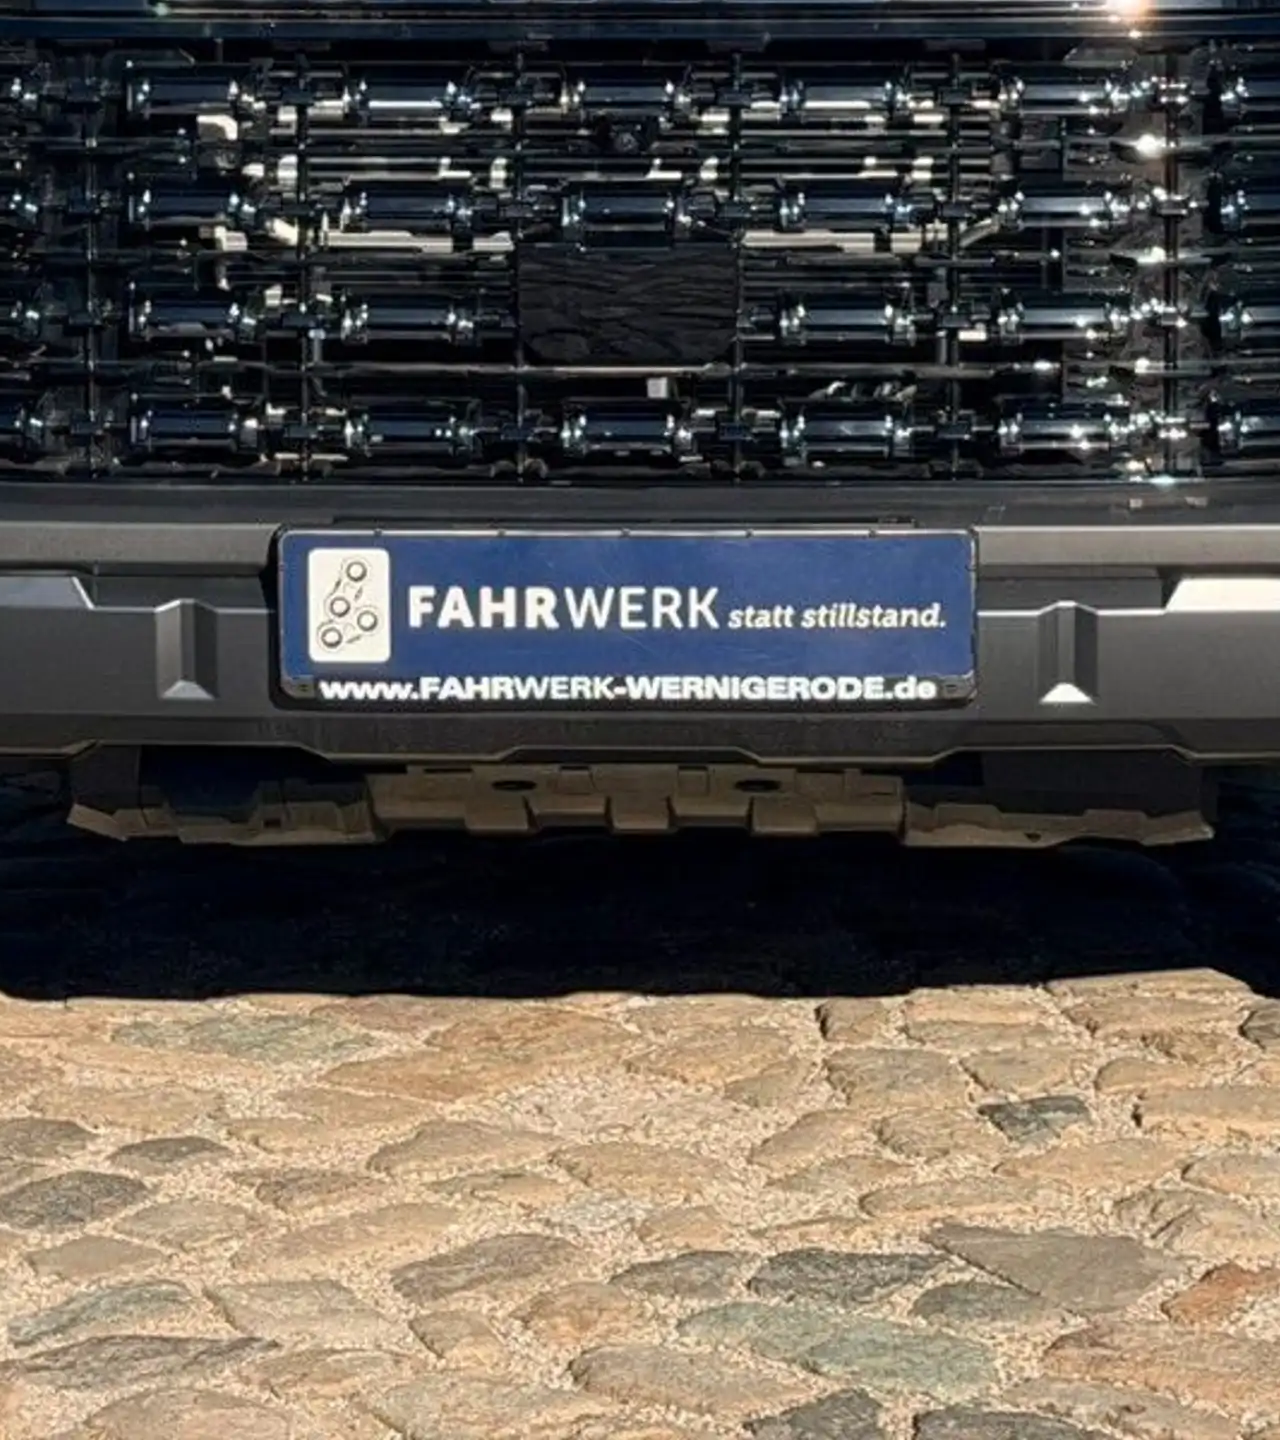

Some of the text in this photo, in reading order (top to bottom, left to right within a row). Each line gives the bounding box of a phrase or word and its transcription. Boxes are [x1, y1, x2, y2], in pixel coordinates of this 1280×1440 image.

[408, 585, 946, 630] FAHRWERK statt stillstand.
[320, 675, 937, 701] www.FAHRWERK-WERNIGERODE.de
